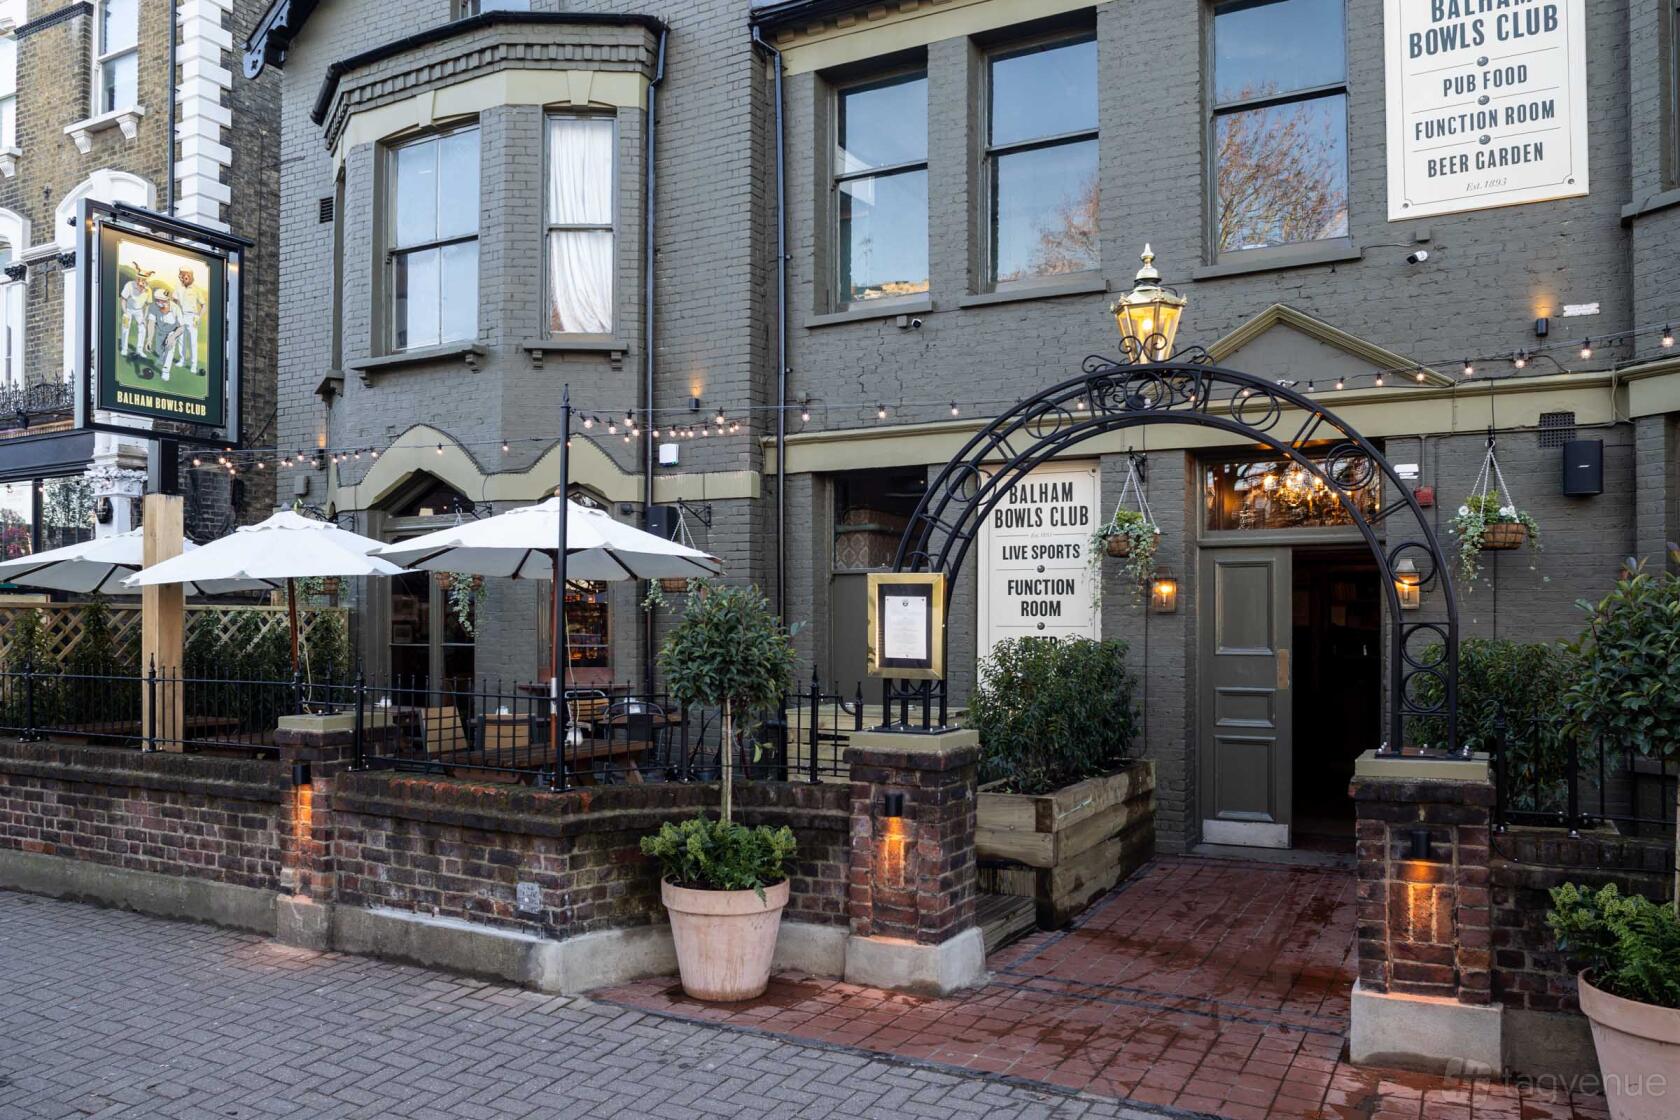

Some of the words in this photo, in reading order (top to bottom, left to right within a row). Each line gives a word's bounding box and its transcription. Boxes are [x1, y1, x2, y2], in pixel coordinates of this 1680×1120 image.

[1431, 0, 1533, 23] BAL
[1409, 19, 1485, 59] BOWLS
[1496, 4, 1558, 41] CLUB
[1443, 74, 1476, 97] PUB
[1483, 64, 1528, 90] FOOD
[1415, 108, 1498, 141] FUNCTION
[1505, 99, 1555, 126] ROOM
[1428, 154, 1469, 178] BEER
[1475, 142, 1544, 170] GARDEN
[117, 391, 153, 408] BALHAM
[155, 397, 184, 413] BOWLS
[185, 402, 206, 416] CLUB
[1009, 482, 1073, 504] BALHAM
[995, 507, 1043, 528] BOWLS
[1050, 505, 1089, 527] CLUB
[1002, 545, 1028, 561] LIVE
[1031, 544, 1080, 560] SPORTS
[1007, 579, 1075, 596] FUNCTION
[1021, 600, 1062, 617] ROOM
